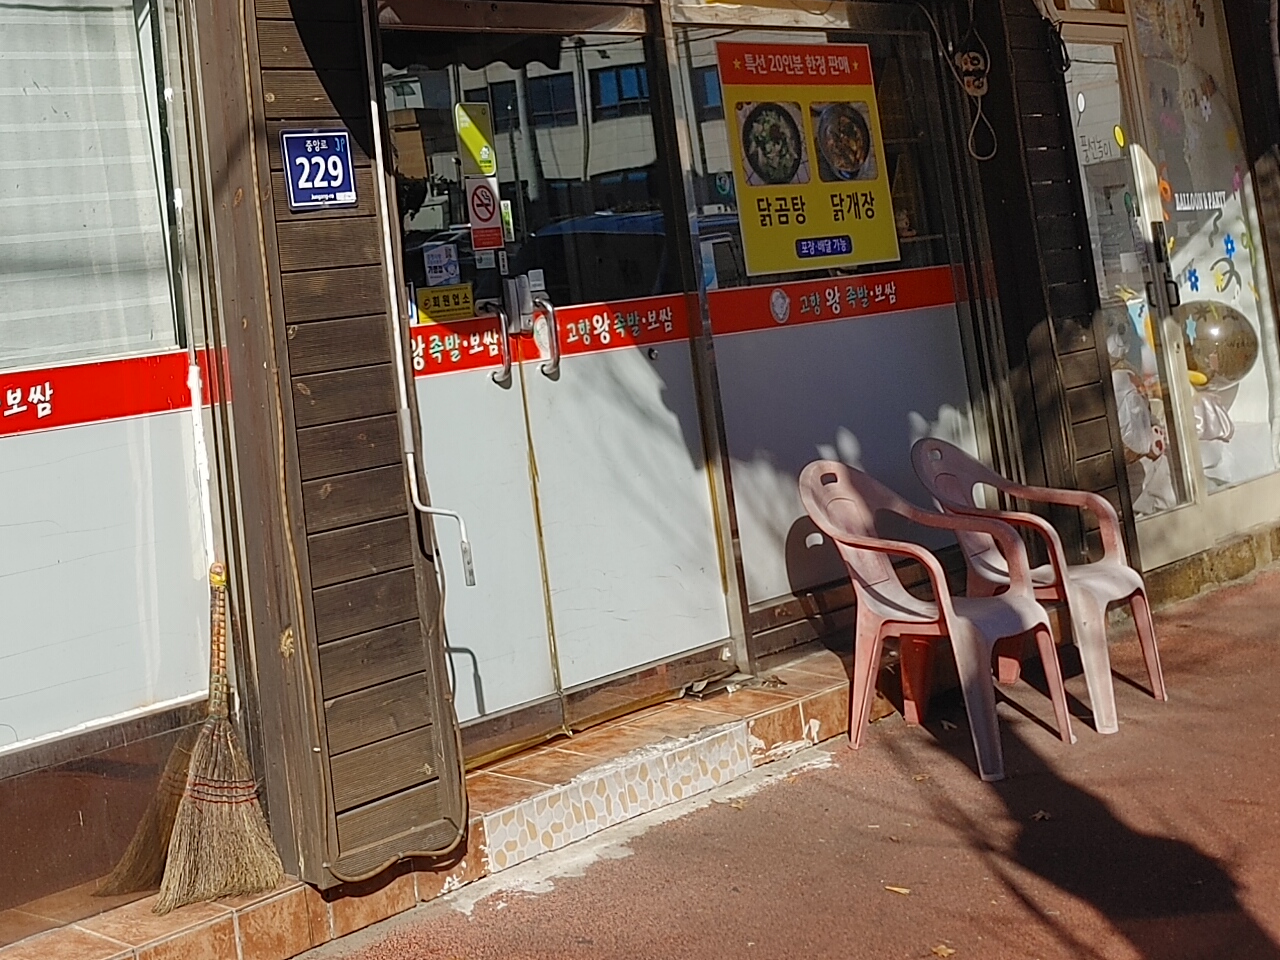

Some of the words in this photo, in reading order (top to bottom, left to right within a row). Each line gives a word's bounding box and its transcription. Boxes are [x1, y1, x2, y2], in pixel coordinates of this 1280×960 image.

[744, 54, 767, 74] 특선
[769, 55, 804, 75] 20인분
[806, 55, 827, 75] 한정
[828, 55, 851, 75] 판매
[305, 140, 328, 152] 중앙로
[295, 155, 344, 189] 229
[756, 195, 806, 227] 닭곰탕
[830, 191, 875, 222] 닭개장
[799, 293, 821, 315] 고향
[825, 286, 841, 315] 왕
